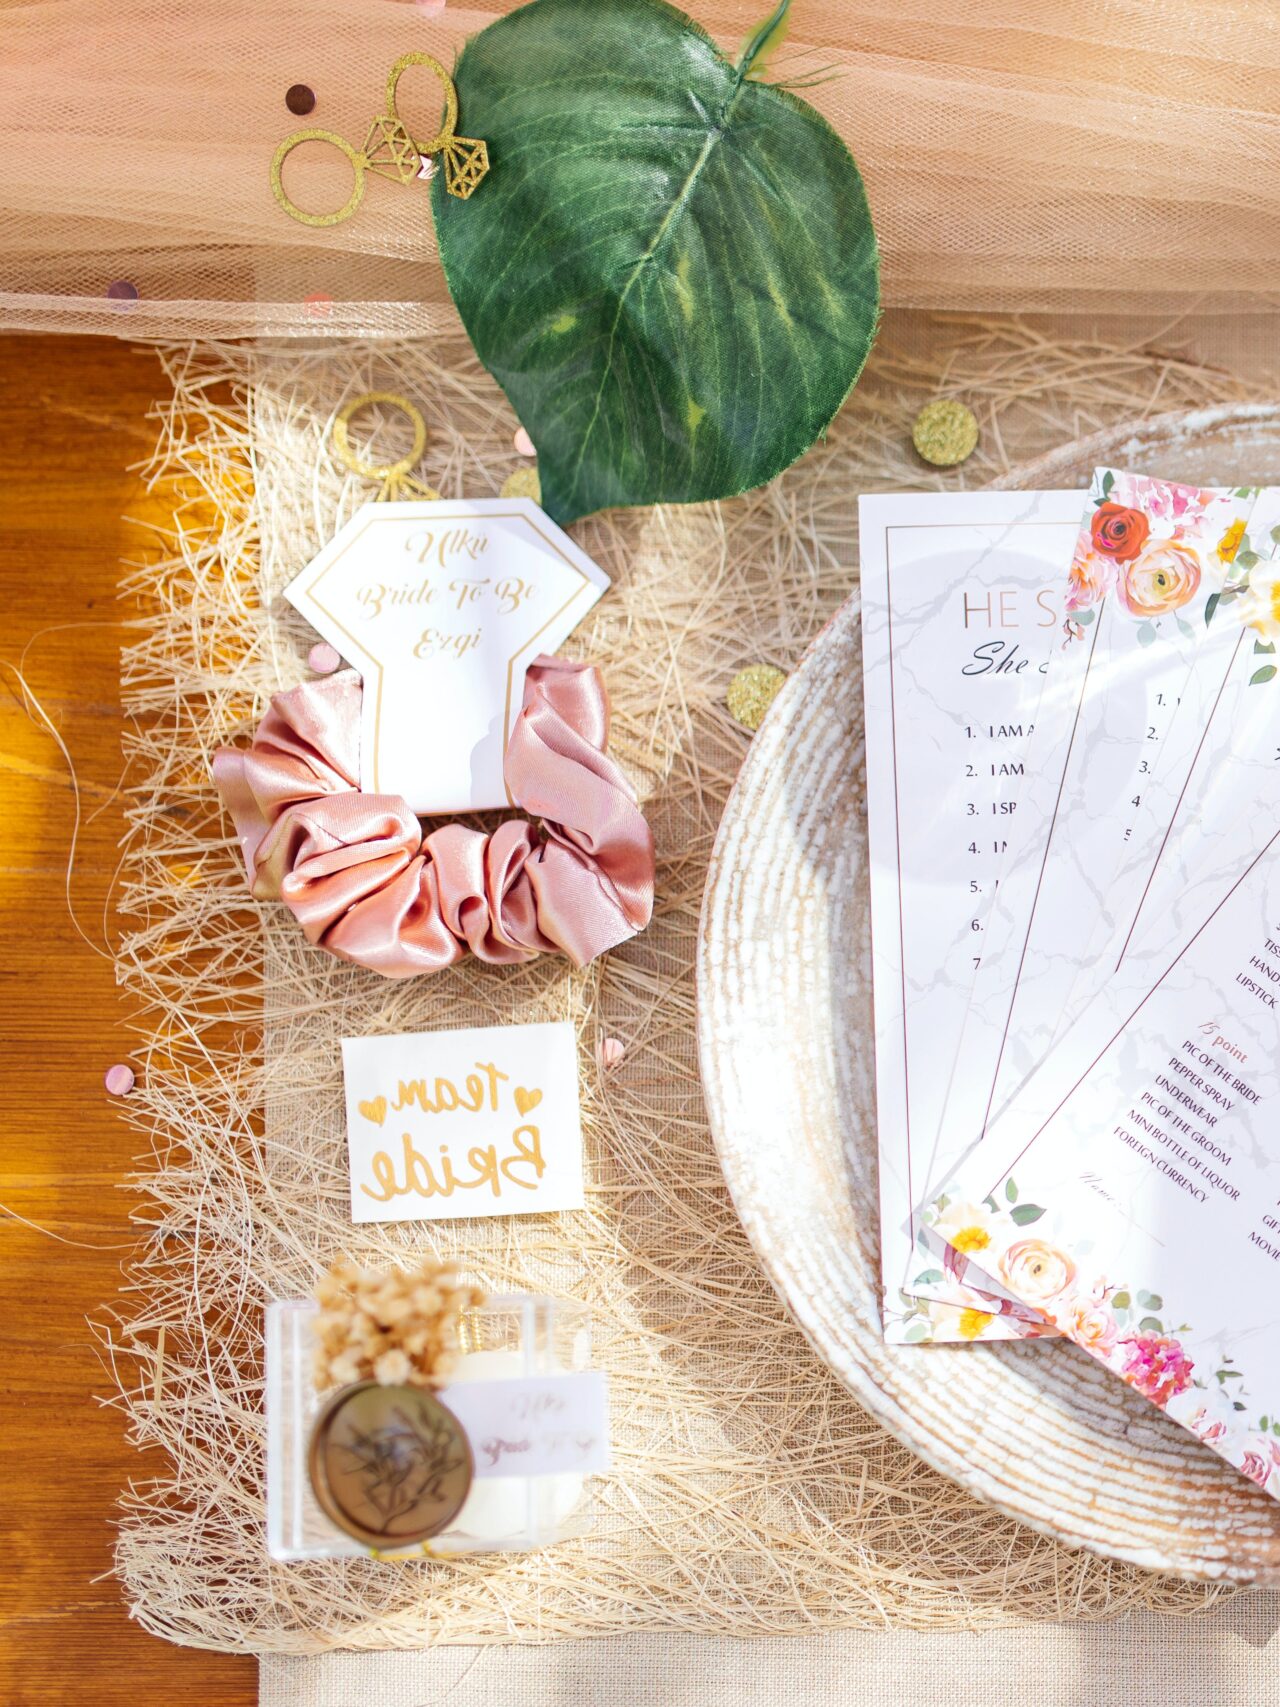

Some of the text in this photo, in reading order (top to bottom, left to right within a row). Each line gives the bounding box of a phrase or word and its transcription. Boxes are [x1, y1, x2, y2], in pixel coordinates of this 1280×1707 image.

[963, 590, 1020, 629] HE
[961, 640, 1030, 676] She
[965, 726, 977, 739] 1.
[998, 724, 1024, 738] AM
[965, 764, 978, 777] 2.
[967, 803, 980, 816] 3.
[968, 841, 981, 854] 4.
[971, 919, 984, 931] 6.
[1249, 955, 1280, 982] HAND
[1235, 972, 1278, 1009] LIPSTICK
[1198, 1022, 1248, 1063] 15 point
[1168, 1057, 1235, 1111] PEPPER SPRAY
[1182, 1040, 1262, 1105] PIC OF THE BRIDE
[1155, 1074, 1218, 1128] UNDERWEAR
[1140, 1092, 1232, 1166] PIC OF THE GROOM
[1113, 1126, 1209, 1203] FOREIGN CURRENCY
[1128, 1109, 1240, 1201] MINI BOTTLE OF LIQUOR
